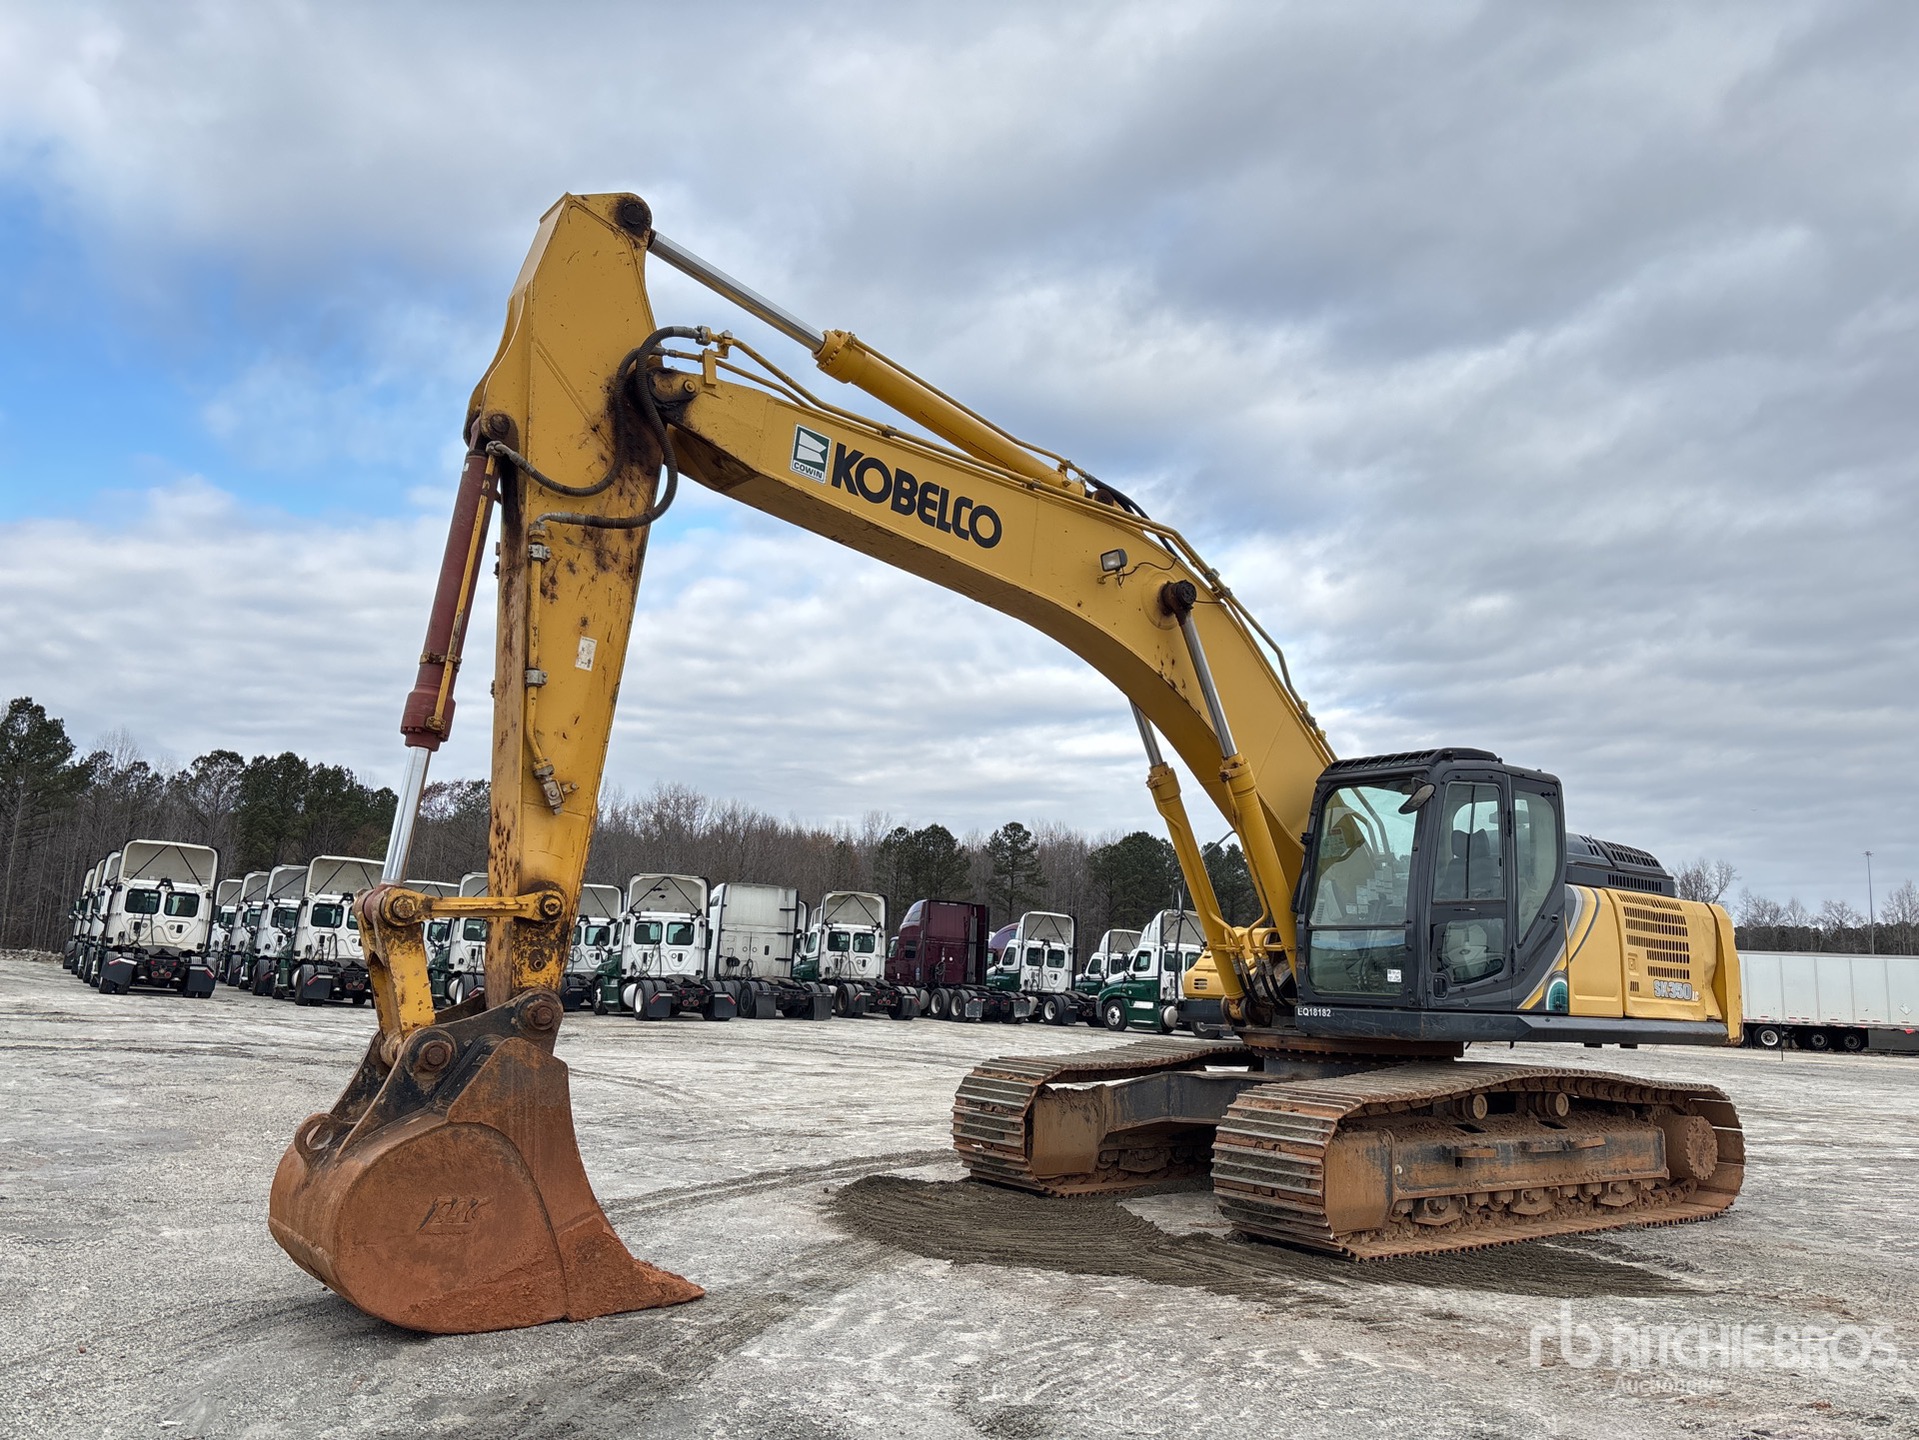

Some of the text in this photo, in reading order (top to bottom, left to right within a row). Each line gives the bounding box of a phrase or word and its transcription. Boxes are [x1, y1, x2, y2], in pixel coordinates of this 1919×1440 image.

[794, 462, 823, 479] COWIN
[831, 442, 1003, 549] KOBELCO
[1297, 1007, 1331, 1018] EQ18182
